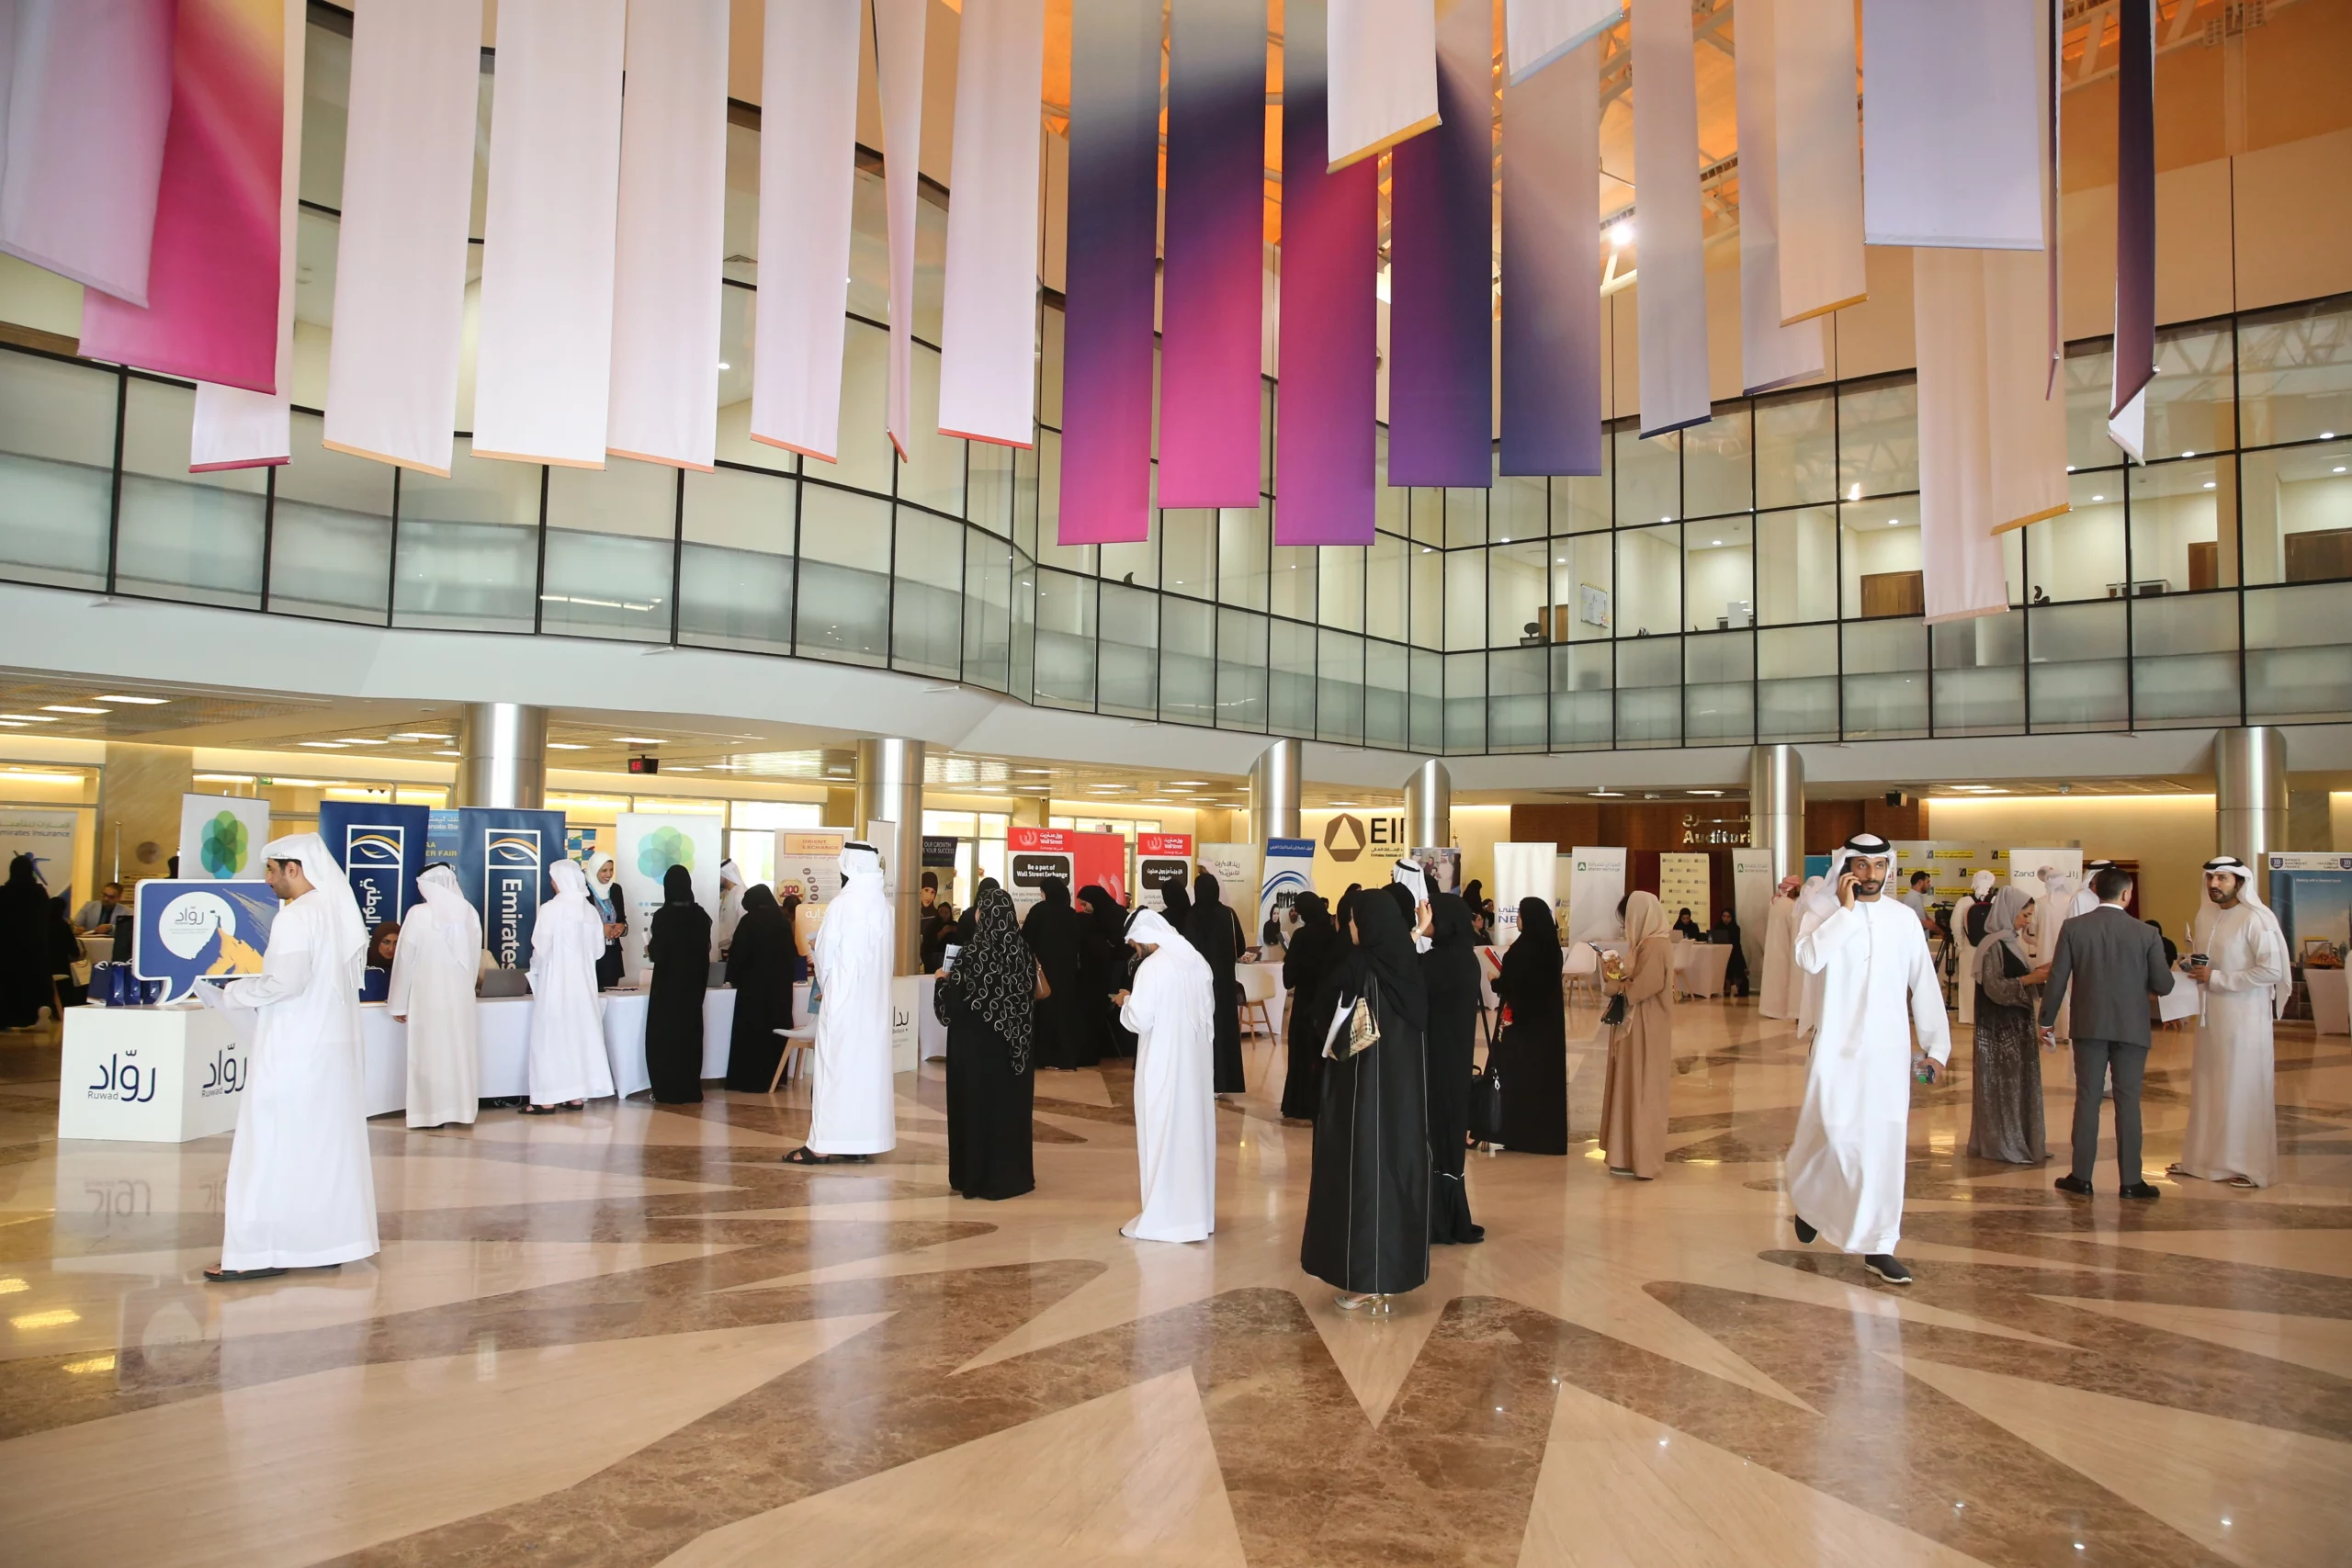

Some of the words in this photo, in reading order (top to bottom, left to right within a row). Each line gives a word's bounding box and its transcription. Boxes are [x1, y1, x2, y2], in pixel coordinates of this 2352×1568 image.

[784, 885, 799, 894] 100
[501, 879, 522, 969] Emirates
[87, 1090, 119, 1100] Ruwad
[200, 1087, 223, 1098] Ruwad
